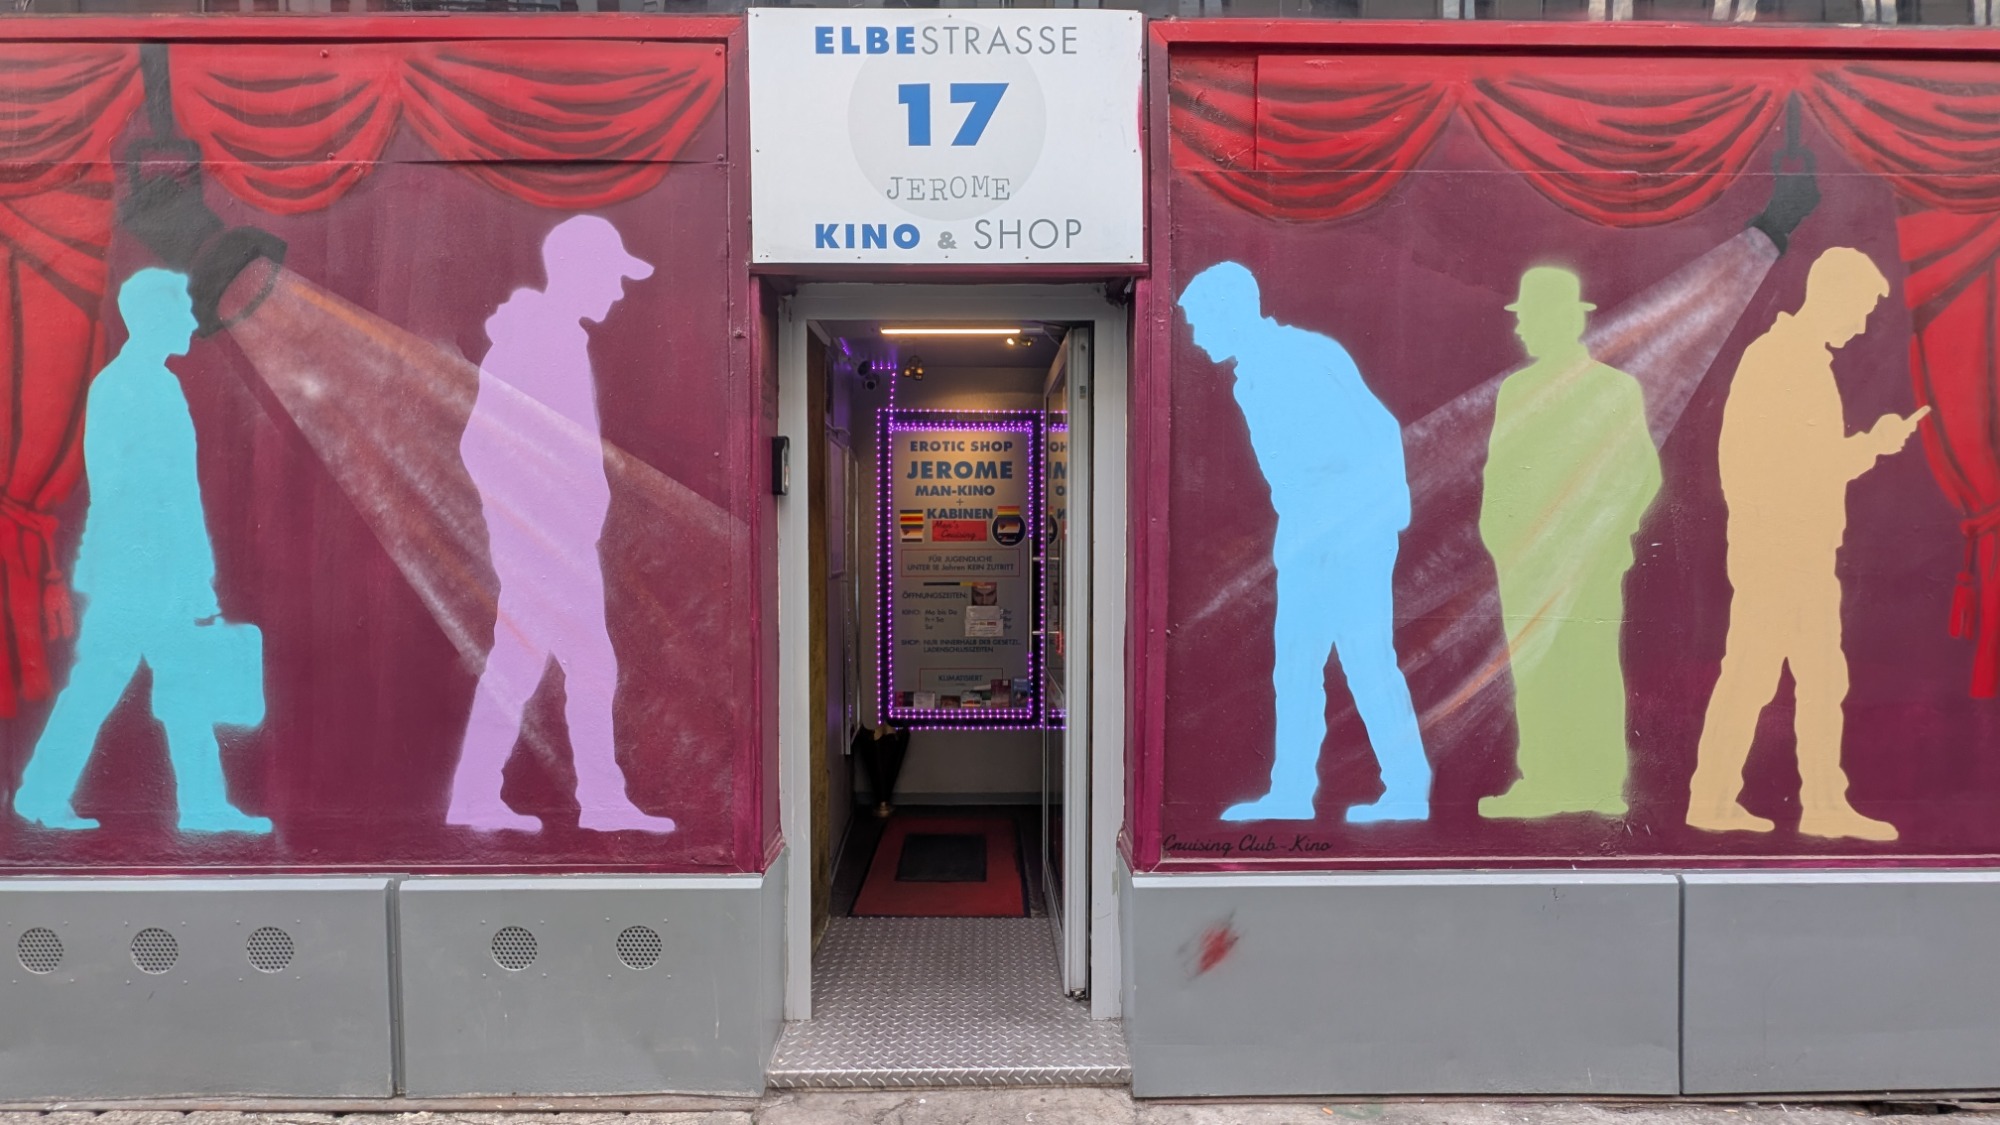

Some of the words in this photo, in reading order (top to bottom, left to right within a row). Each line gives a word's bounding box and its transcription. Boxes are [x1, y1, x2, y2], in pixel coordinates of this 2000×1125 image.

[815, 26, 1078, 55] ELBESTRASSE
[898, 82, 1010, 147] 17
[886, 175, 1011, 202] JEROME
[815, 223, 921, 249] KINO
[937, 231, 957, 249] &
[974, 218, 1083, 250] SHOP
[910, 440, 966, 453] EROTIC
[970, 440, 1013, 453] SHOP
[906, 460, 1013, 480] JEROME
[914, 484, 996, 497] MAN-KINO
[926, 508, 994, 519] KABINEN
[928, 554, 942, 563] FÜR
[944, 555, 992, 563] JUGENDLICHE
[907, 563, 931, 571] UNTER
[941, 563, 966, 571] Jahren
[967, 563, 985, 571] KEIN
[986, 563, 1014, 571] ZUTRITT
[938, 674, 983, 682] KLIMATISIERT
[1162, 834, 1233, 857] Cruising
